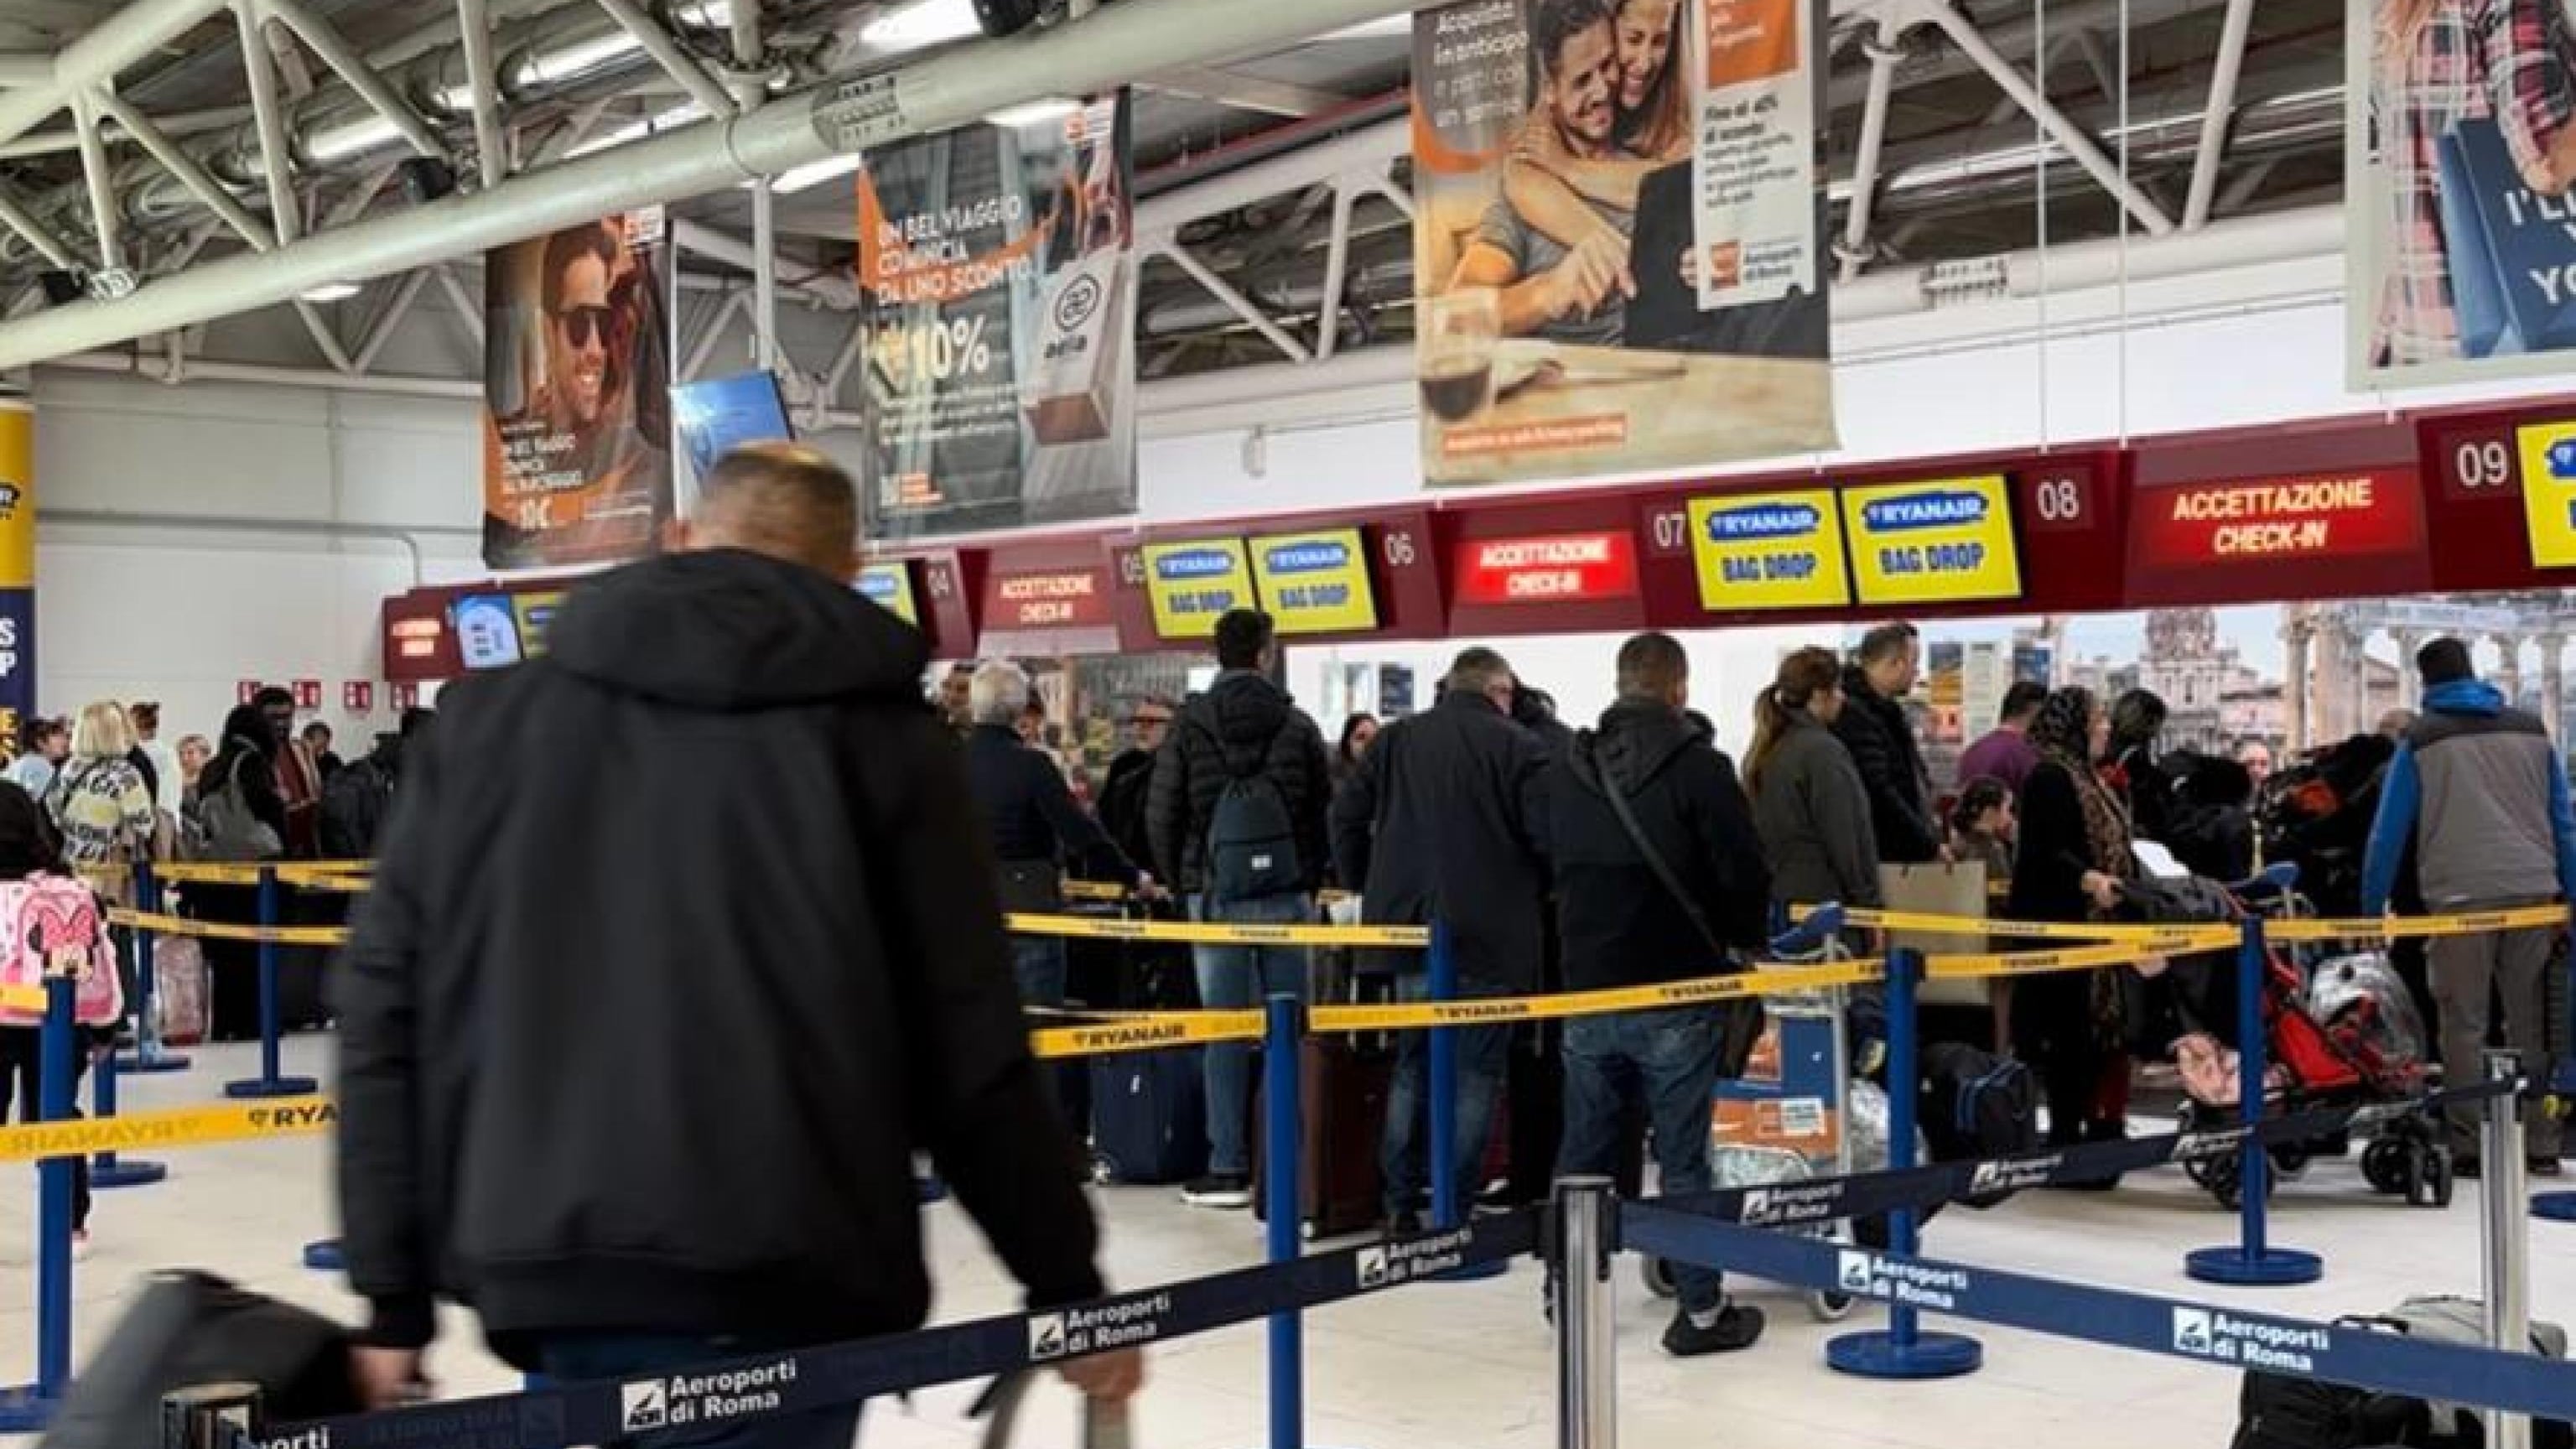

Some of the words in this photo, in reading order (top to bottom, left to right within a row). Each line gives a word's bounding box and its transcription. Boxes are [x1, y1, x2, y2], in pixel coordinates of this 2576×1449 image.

[2457, 441, 2509, 487] 09
[1883, 496, 1980, 523] RYANAIR
[2037, 480, 2080, 521] 08
[2173, 479, 2375, 521] ACCETTAZIONE
[1654, 512, 1685, 548] 07
[1724, 512, 1814, 533] RYANAIR
[2213, 520, 2328, 554] CHECK-IN
[1386, 532, 1415, 567] 06
[1879, 547, 1921, 574] BAG
[1925, 542, 1986, 572] DROP
[1722, 557, 1759, 583] BAG
[1763, 552, 1817, 580] DROP
[1089, 1022, 1186, 1047] RYANAIR
[1389, 1227, 1474, 1259] Aeroporti
[1388, 1260, 1407, 1281] di
[1410, 1253, 1463, 1278] Roma
[1871, 1254, 1968, 1291] Aeroporti
[1872, 1275, 1893, 1297] di
[1895, 1280, 1955, 1310] Roma
[1066, 1291, 1171, 1330] Aeroporti
[1067, 1330, 1089, 1353] di
[1095, 1322, 1158, 1349] Roma
[2212, 1313, 2329, 1351] Aeroporti
[2213, 1337, 2236, 1359] di
[2242, 1342, 2314, 1372] Roma
[669, 1357, 797, 1400] Aeroporti
[670, 1396, 695, 1424] di
[703, 1389, 782, 1420] Roma
